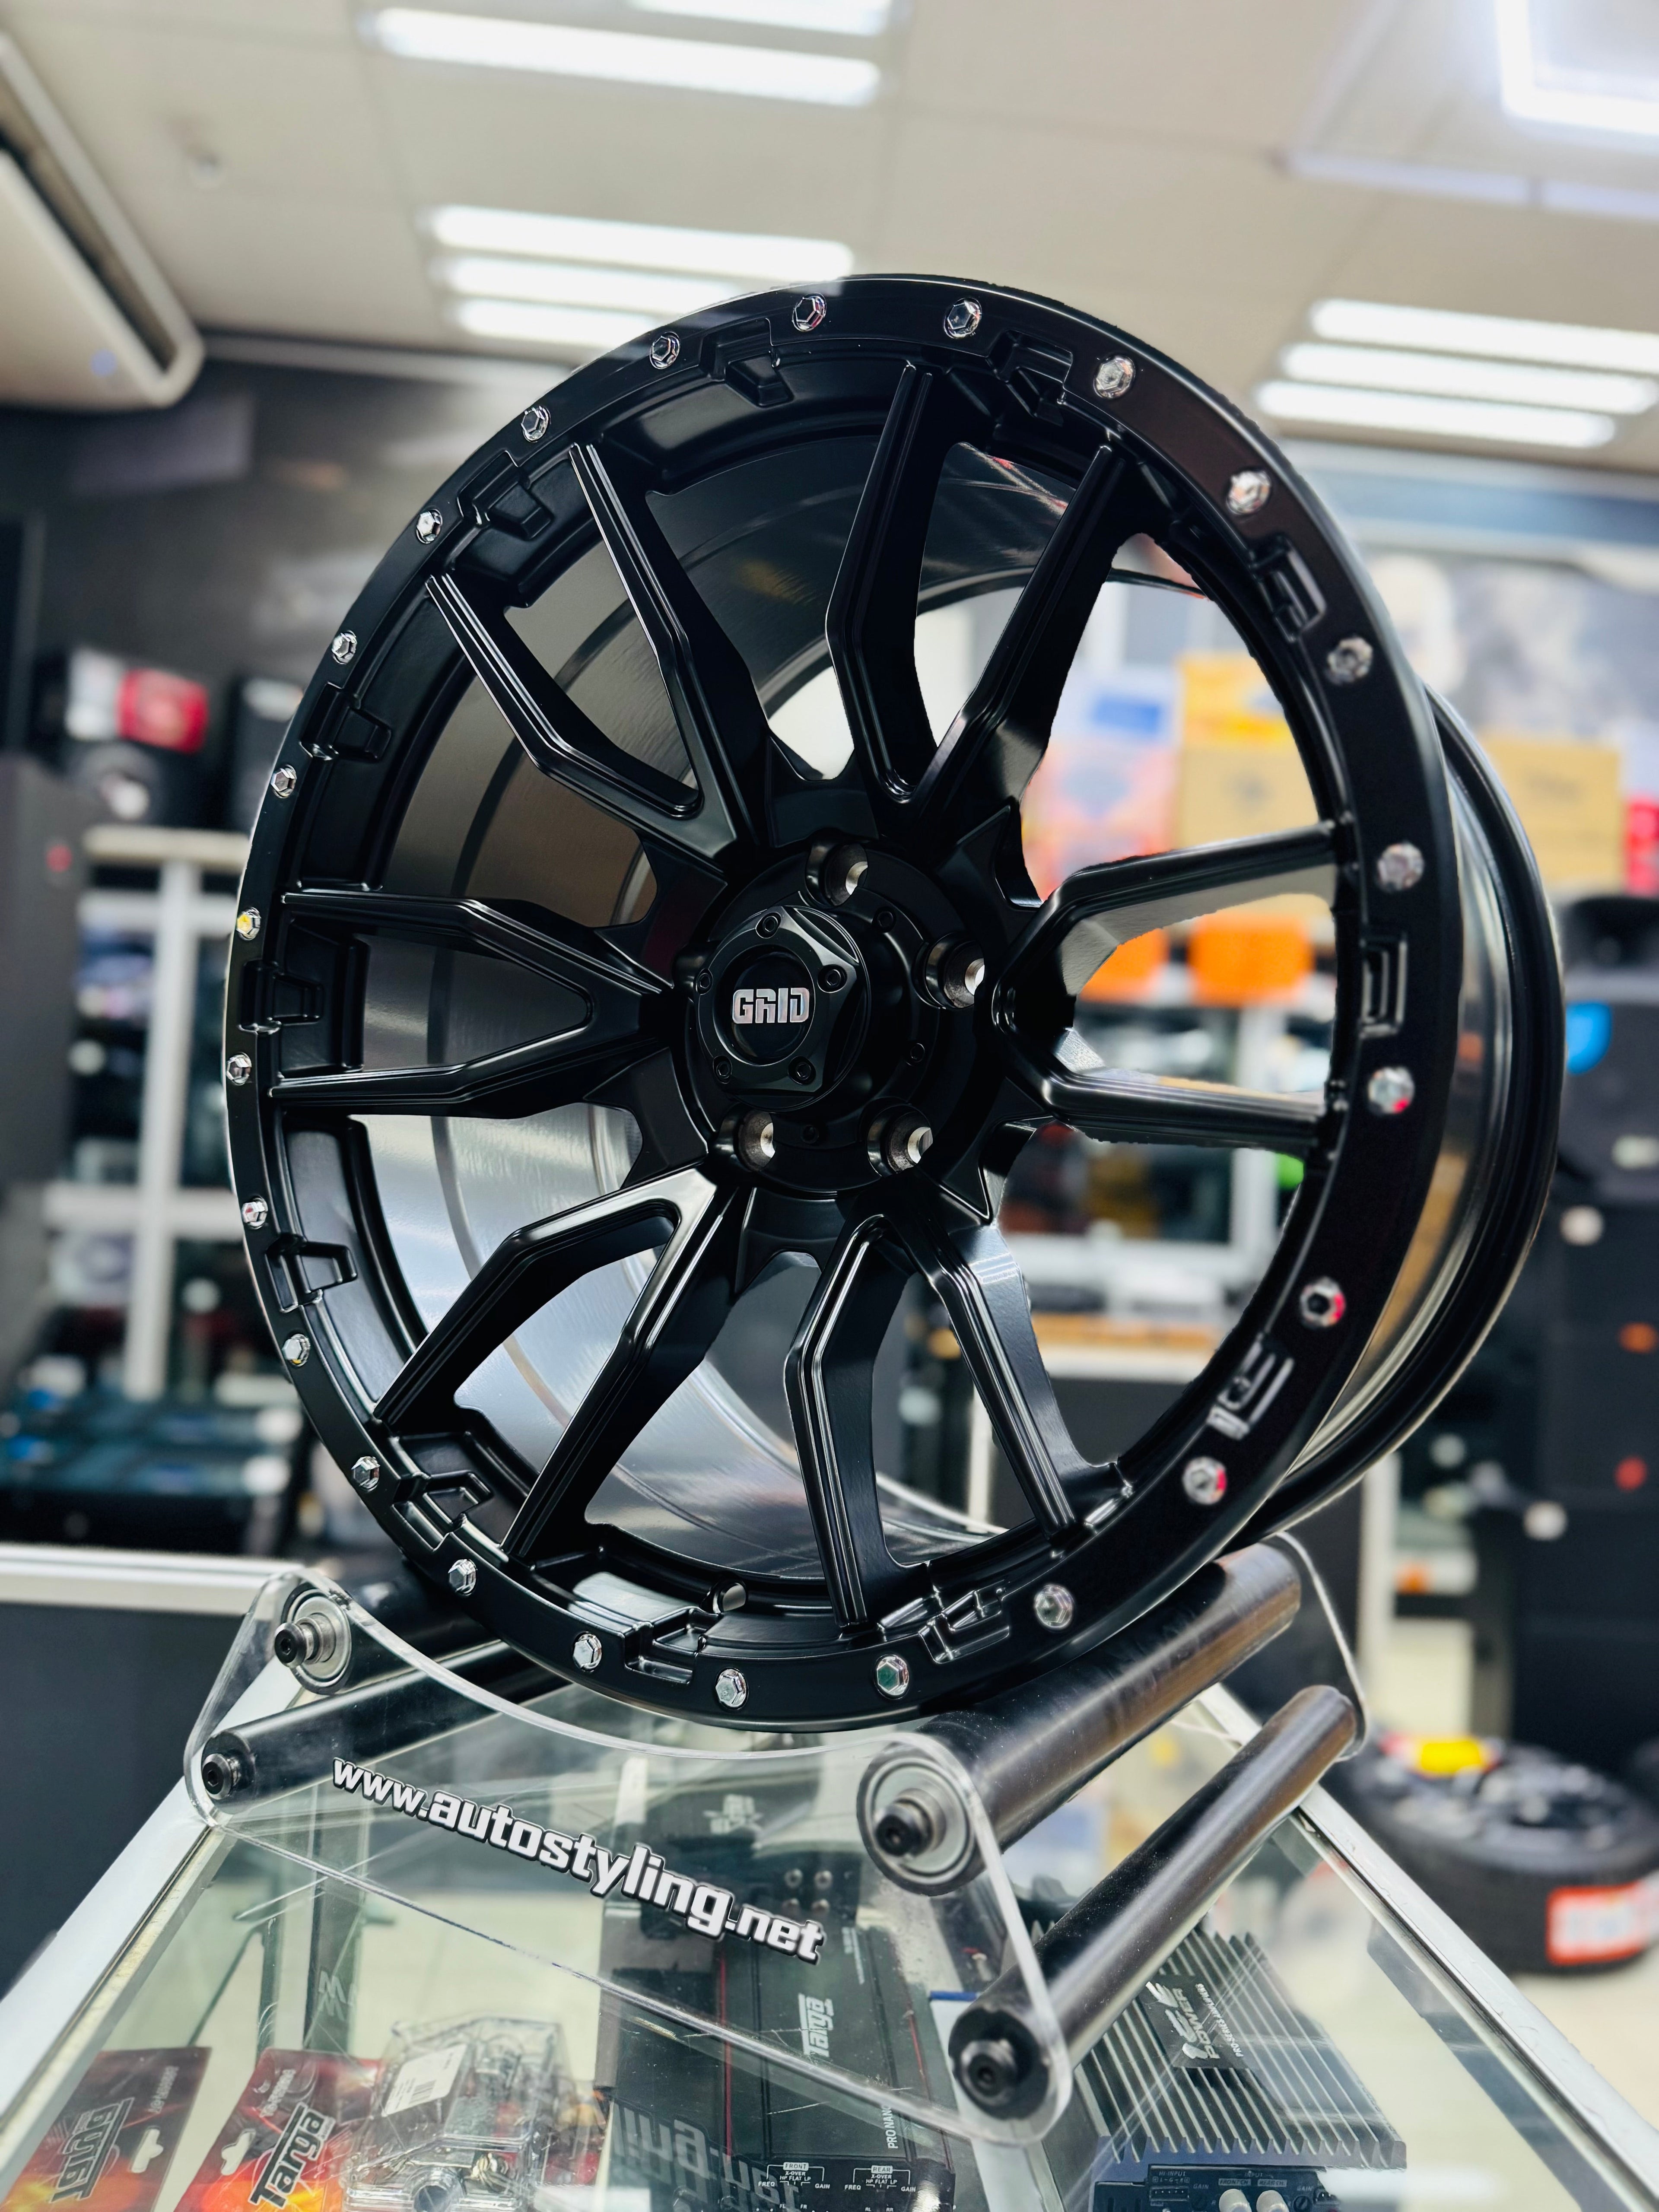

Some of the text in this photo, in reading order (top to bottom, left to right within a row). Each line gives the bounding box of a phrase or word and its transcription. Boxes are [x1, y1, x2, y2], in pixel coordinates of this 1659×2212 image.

[731, 987, 810, 1024] GRID
[333, 1757, 826, 1965] www.autostyling.net
[798, 1993, 833, 2058] Targa
[1172, 1988, 1220, 2059] POWER
[248, 2102, 324, 2209] Targa
[885, 2129, 899, 2149] PRO
